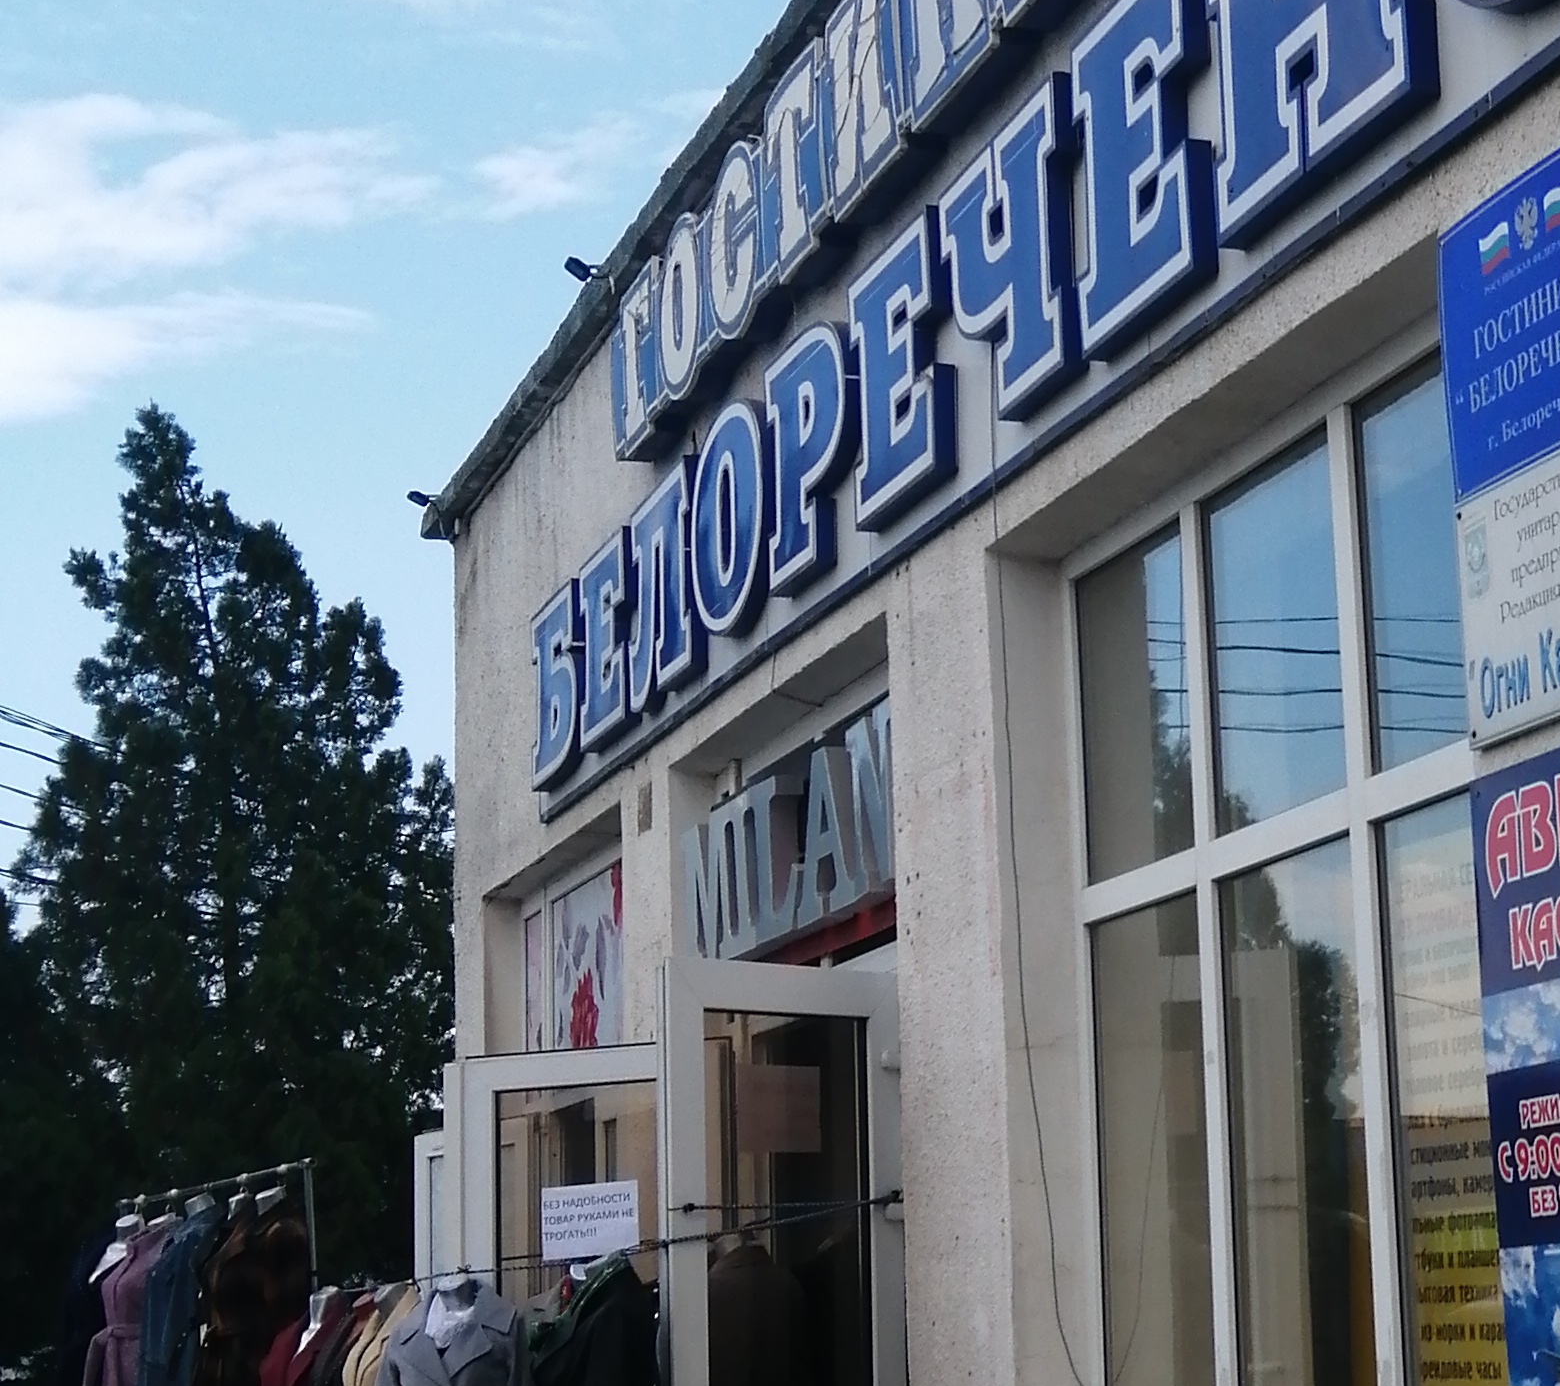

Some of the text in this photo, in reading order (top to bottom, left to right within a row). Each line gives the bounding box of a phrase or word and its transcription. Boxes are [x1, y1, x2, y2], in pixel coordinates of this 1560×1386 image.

[1488, 431, 1498, 451] г.
[1498, 1139, 1514, 1182] С
[543, 1193, 630, 1210] БЕЗ НАДОБНОСТИ
[1530, 1187, 1558, 1218] БЕЗ
[544, 1208, 634, 1225] ТОВАР РУКАМИ НЕ
[543, 1227, 597, 1242] ТРОГАТЬ!!!
[1469, 1323, 1475, 1341] и
[1476, 1361, 1502, 1379] часы
